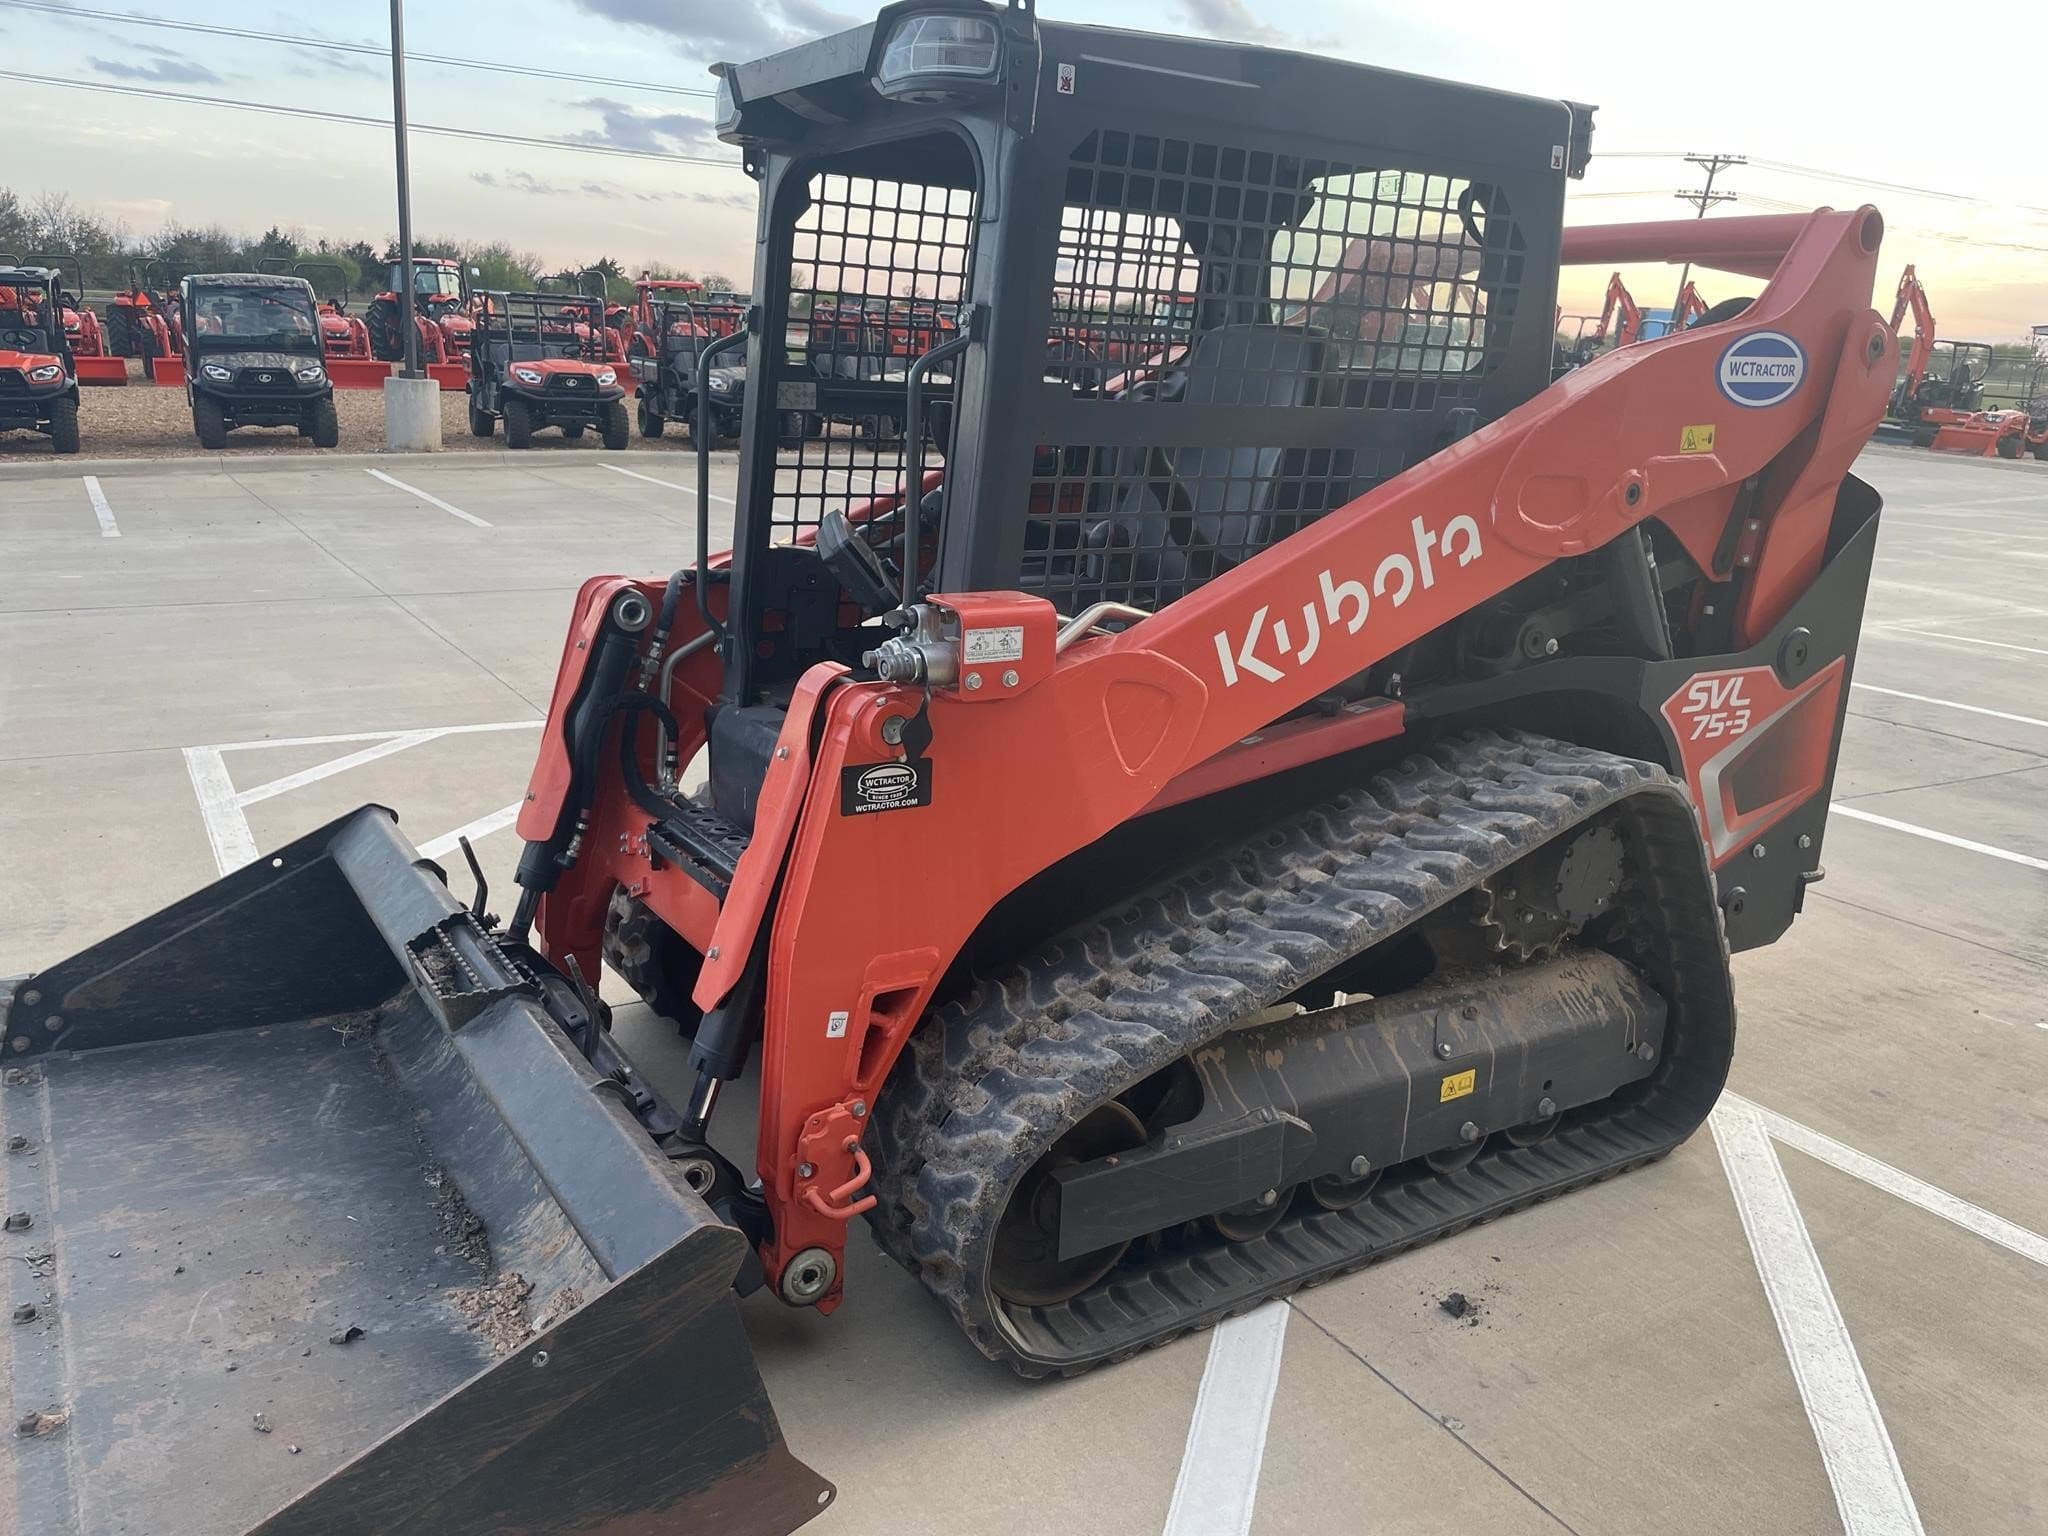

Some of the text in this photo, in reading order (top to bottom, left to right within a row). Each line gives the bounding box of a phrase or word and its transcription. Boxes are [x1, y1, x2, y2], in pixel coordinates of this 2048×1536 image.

[1729, 361, 1796, 377] WCTRACTOR
[1214, 514, 1483, 687] Kubota
[1681, 677, 1751, 713] SVL
[1690, 709, 1751, 741] 75-3
[865, 775, 910, 787] WCTRACTOR
[855, 798, 918, 813] WCTRACTOR.COM
